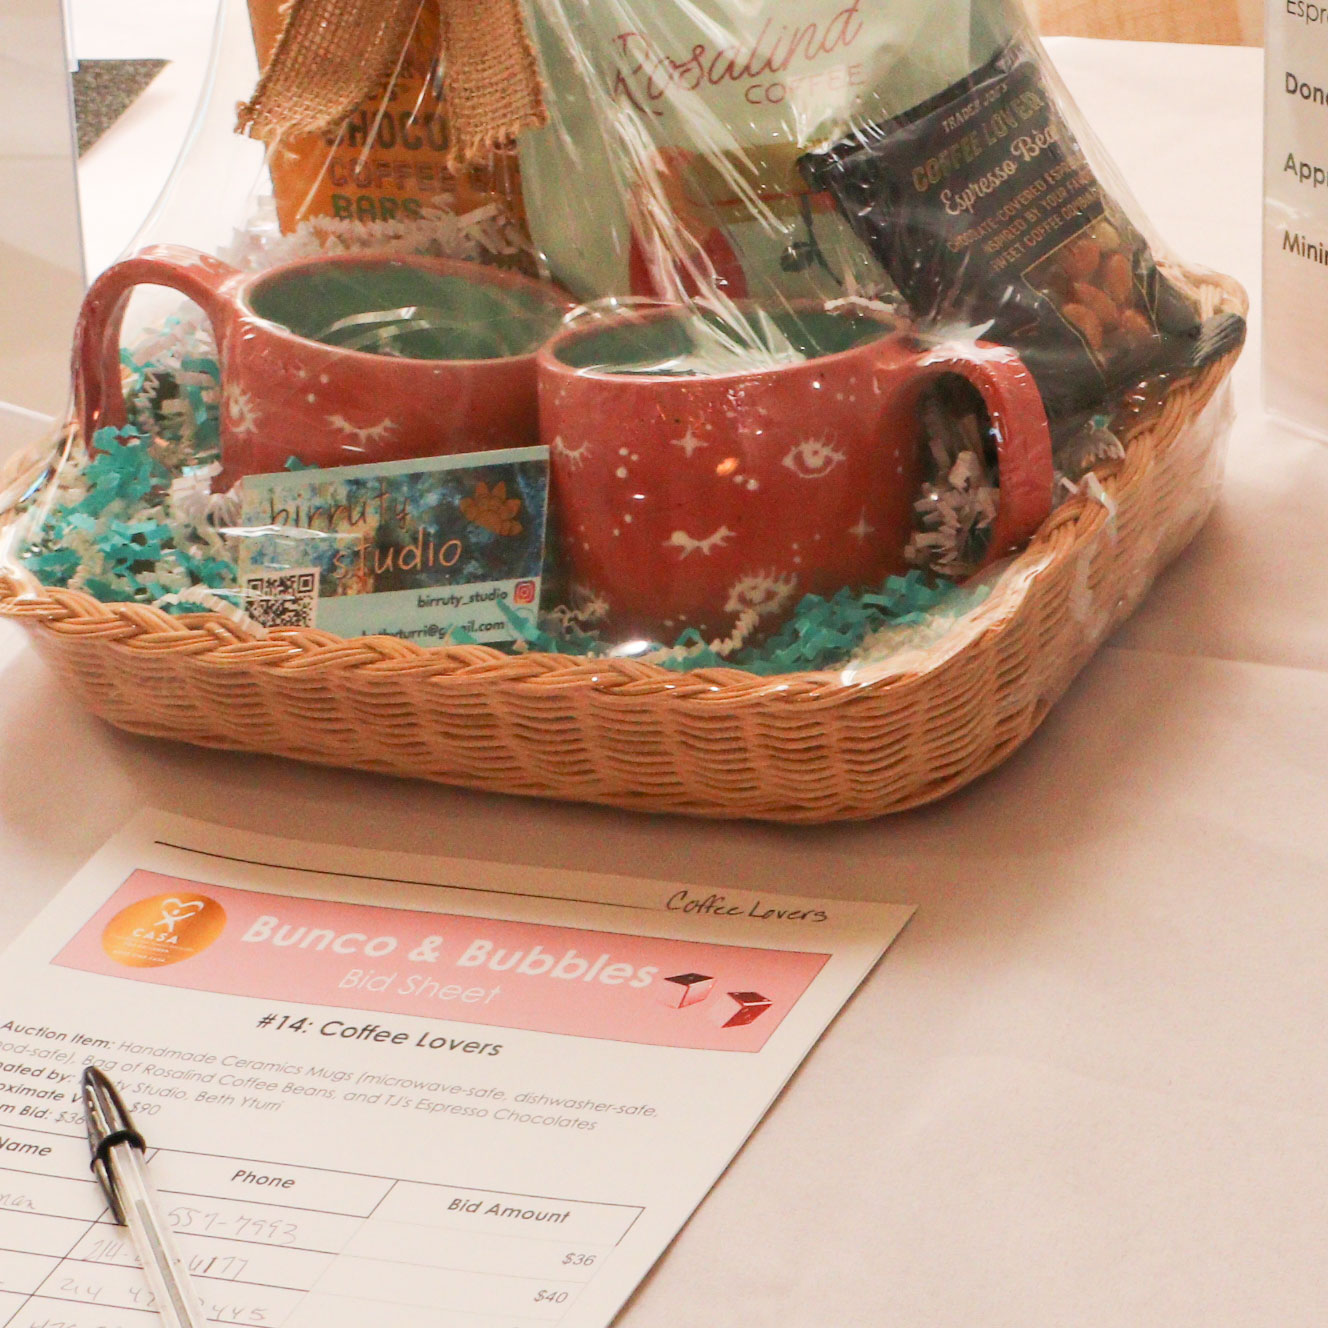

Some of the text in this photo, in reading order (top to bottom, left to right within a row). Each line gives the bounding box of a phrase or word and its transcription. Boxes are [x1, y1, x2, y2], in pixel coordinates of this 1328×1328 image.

[940, 160, 1017, 215] Espresso
[333, 525, 463, 579] studio
[416, 589, 509, 609] birruty_studio
[666, 890, 829, 924] Coffee Lovers
[132, 927, 179, 945] CASA
[241, 915, 398, 958] Bunco
[408, 935, 444, 963] &
[456, 938, 659, 989] Bubbles
[338, 968, 503, 1006] Bid Sheet
[256, 1012, 504, 1057] #14: Coffee Lovers
[0, 1019, 659, 1119] Auction Item: Handmade Ceramics Mugs (microwave-safe, dishwasher-safe,
[47, 1068, 75, 1085] by:
[129, 1082, 189, 1102] Studio,
[190, 1090, 237, 1107] Beth
[81, 1054, 598, 1132] Bag of Rosalind Coffee Beans, and TJ's Espresso Chocolates
[128, 1100, 161, 1117] $90
[19, 1103, 51, 1121] Bid:
[54, 1109, 86, 1126] $36
[0, 1137, 570, 1226] Name Phone Bid Amount
[561, 1252, 597, 1267] $36
[533, 1289, 569, 1305] $40
